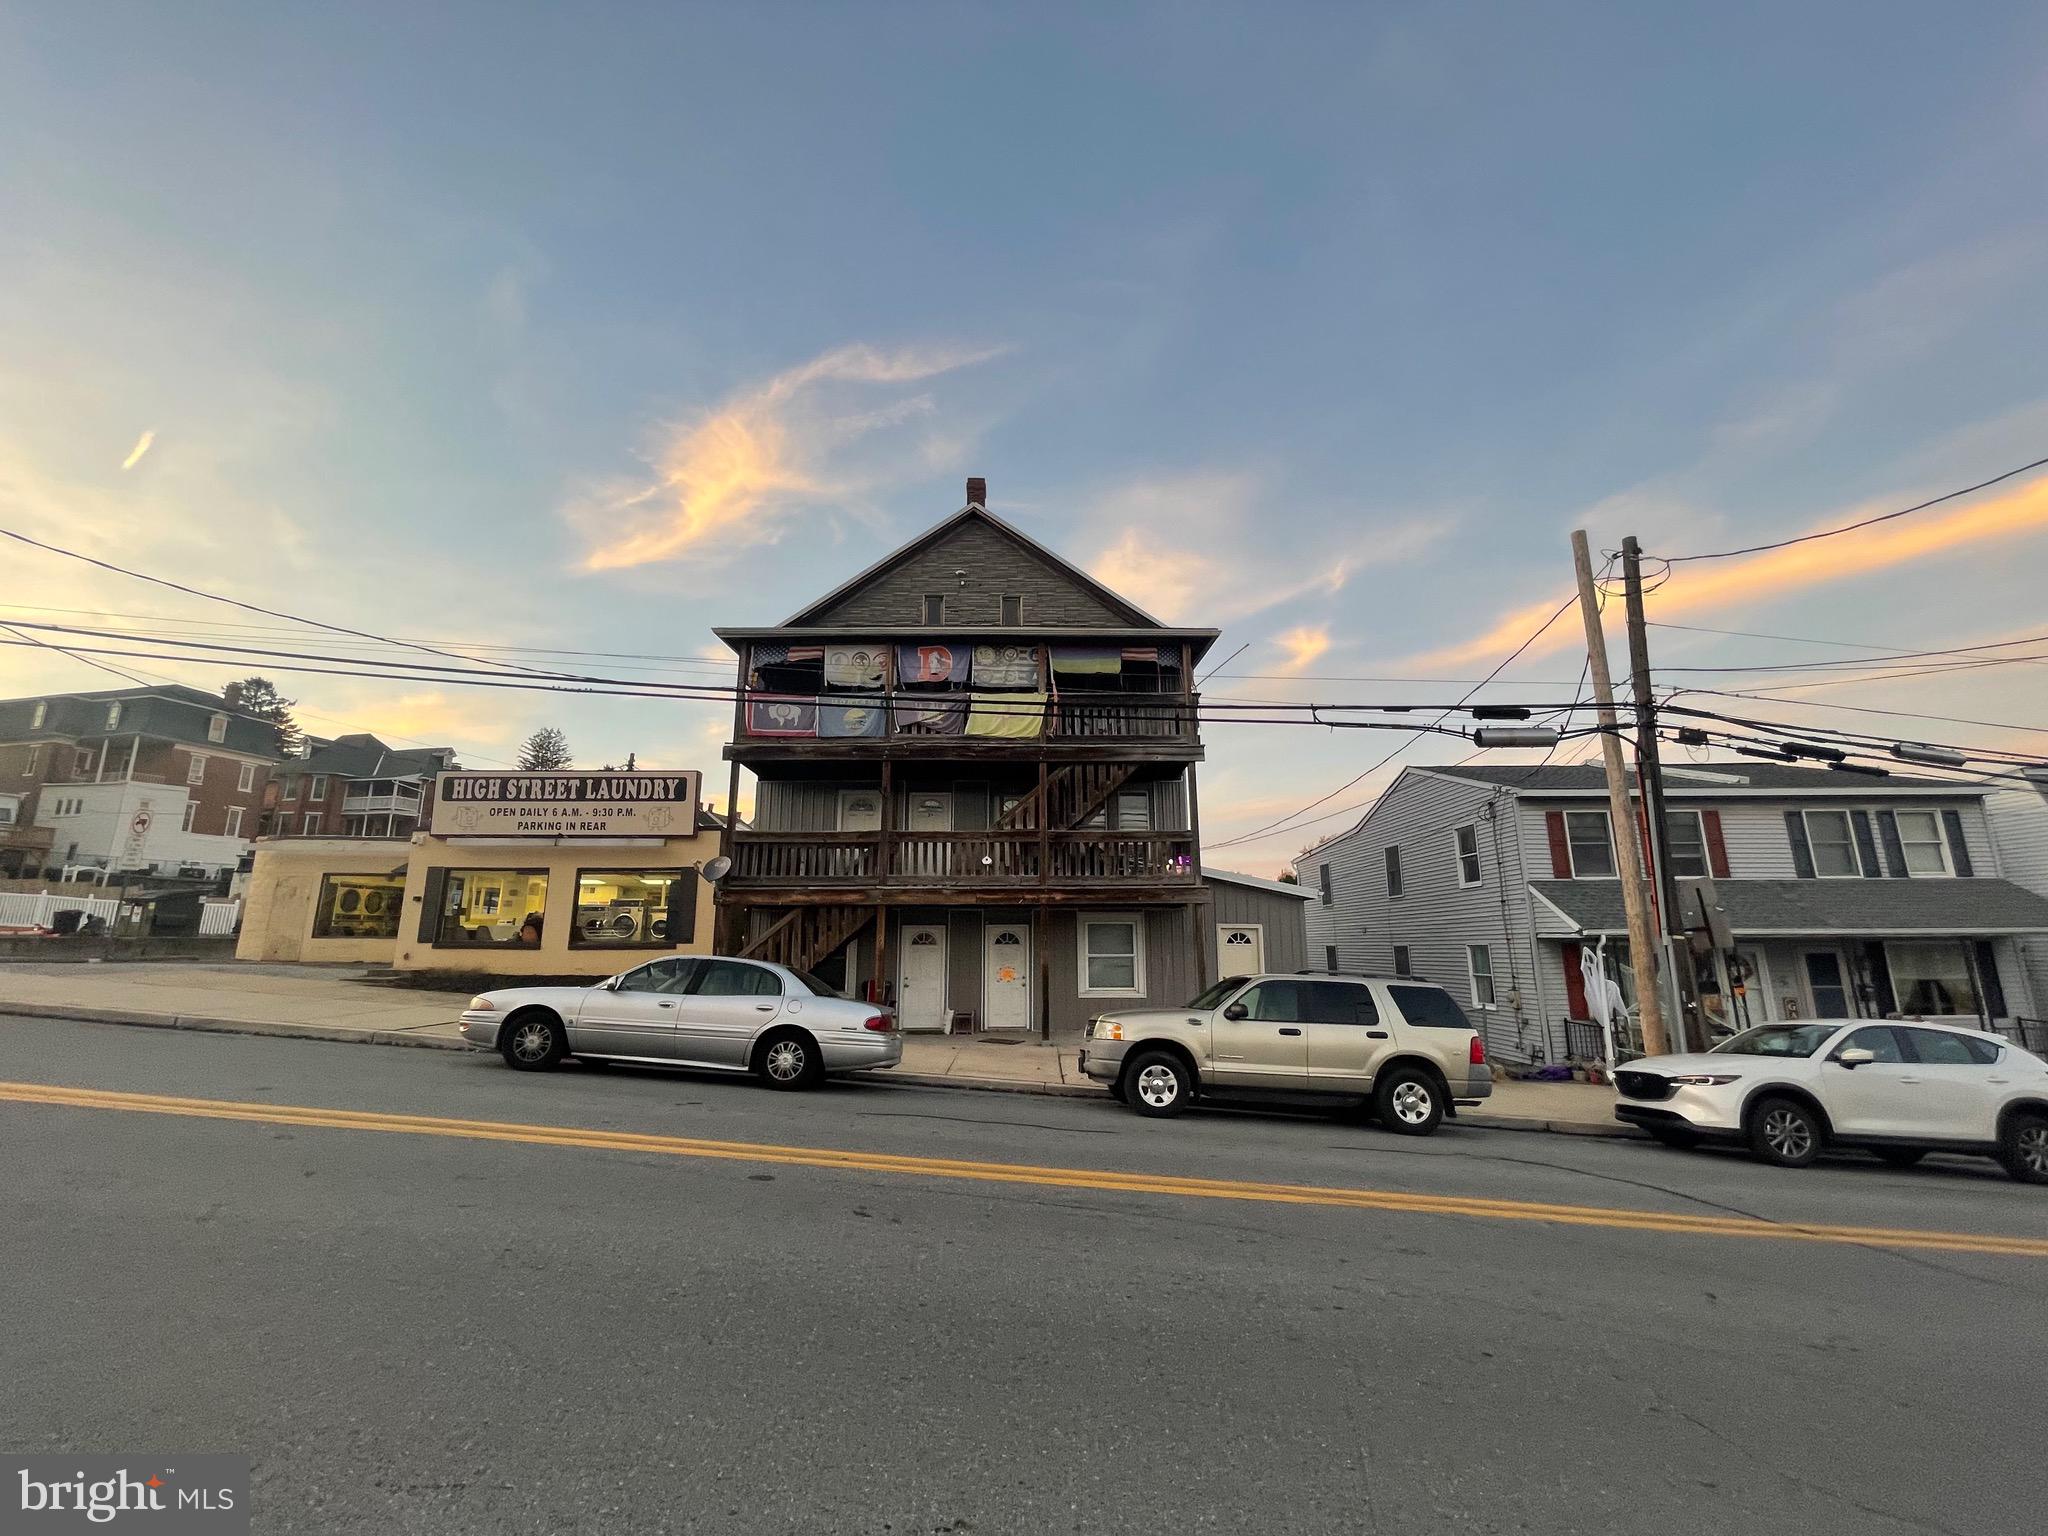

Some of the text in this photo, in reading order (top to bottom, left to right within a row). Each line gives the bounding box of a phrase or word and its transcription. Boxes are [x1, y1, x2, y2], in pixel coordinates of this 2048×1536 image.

[452, 778, 679, 800] HIGH STREET LAUNDRY
[489, 807, 516, 817] OPEN
[520, 807, 549, 817] DAILY
[552, 807, 558, 817] 6
[561, 807, 582, 817] A.M.
[592, 807, 614, 817] 9:30
[617, 807, 637, 817] P.M.
[517, 821, 607, 831] PARKING IN REAR
